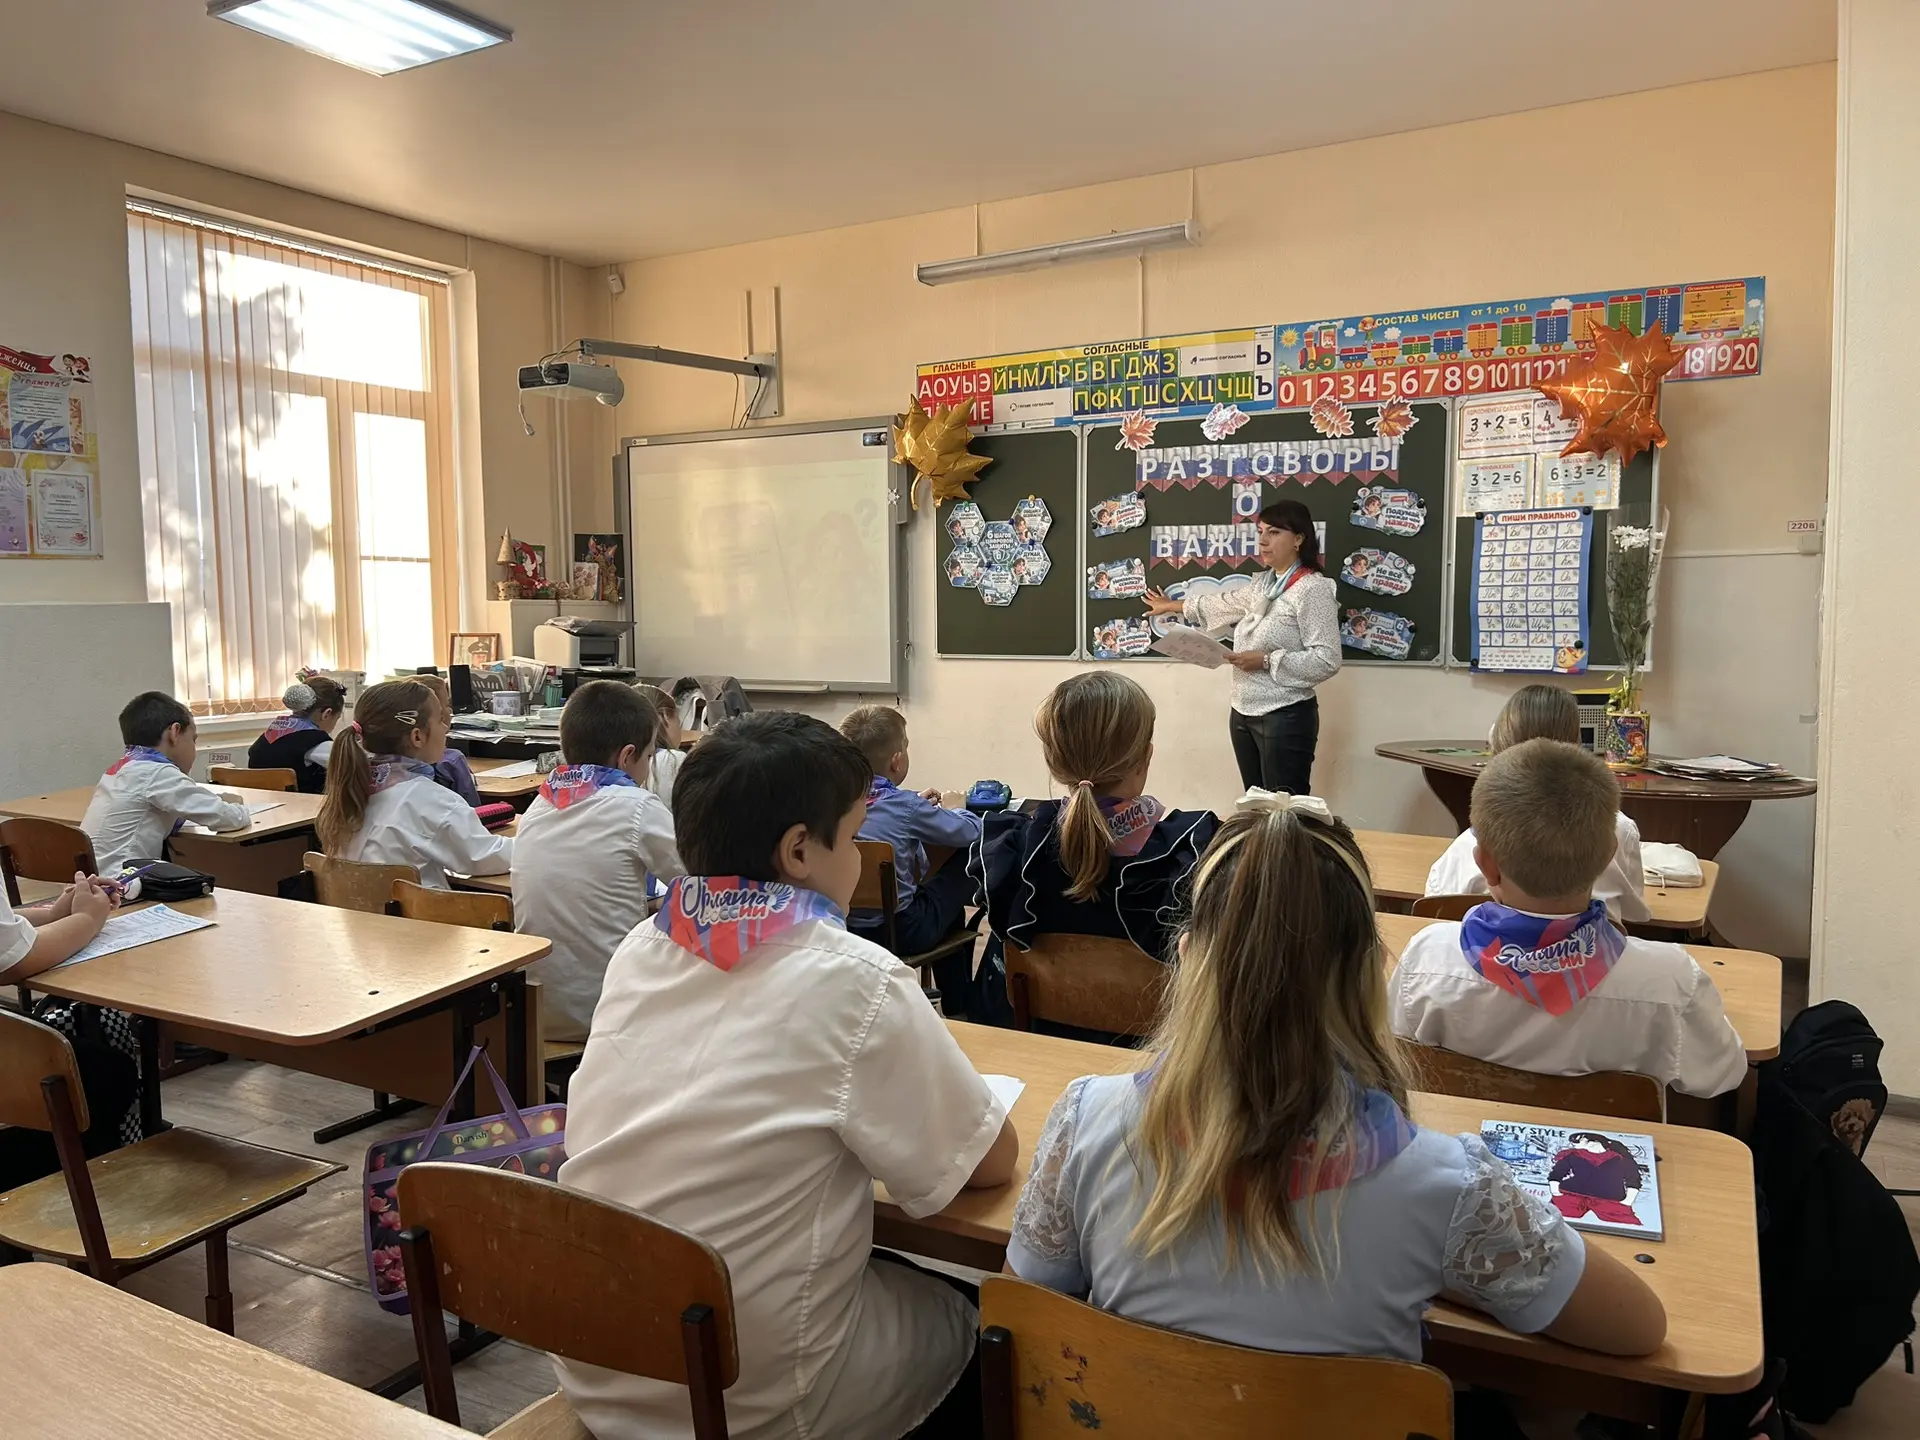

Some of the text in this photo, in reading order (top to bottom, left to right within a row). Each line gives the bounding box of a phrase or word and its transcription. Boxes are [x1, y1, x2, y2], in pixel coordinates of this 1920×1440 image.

[1377, 314, 1418, 326] СОСТАВ
[1422, 310, 1459, 321] ЧИСЕЛ
[1486, 306, 1492, 315] 1
[1494, 306, 1510, 315] до
[1513, 303, 1526, 312] 10
[1083, 340, 1149, 356] СОГЛАСНЫЕ
[933, 360, 976, 373] ГЛАСНЫЕ
[1142, 445, 1399, 481] РАЗГОВОРЫ
[1236, 492, 1258, 516] О
[1502, 511, 1577, 522] ПИШИ ПРАВИЛЬНО
[456, 1130, 488, 1144] Darvish
[1495, 1124, 1566, 1138] CITY STYLE
